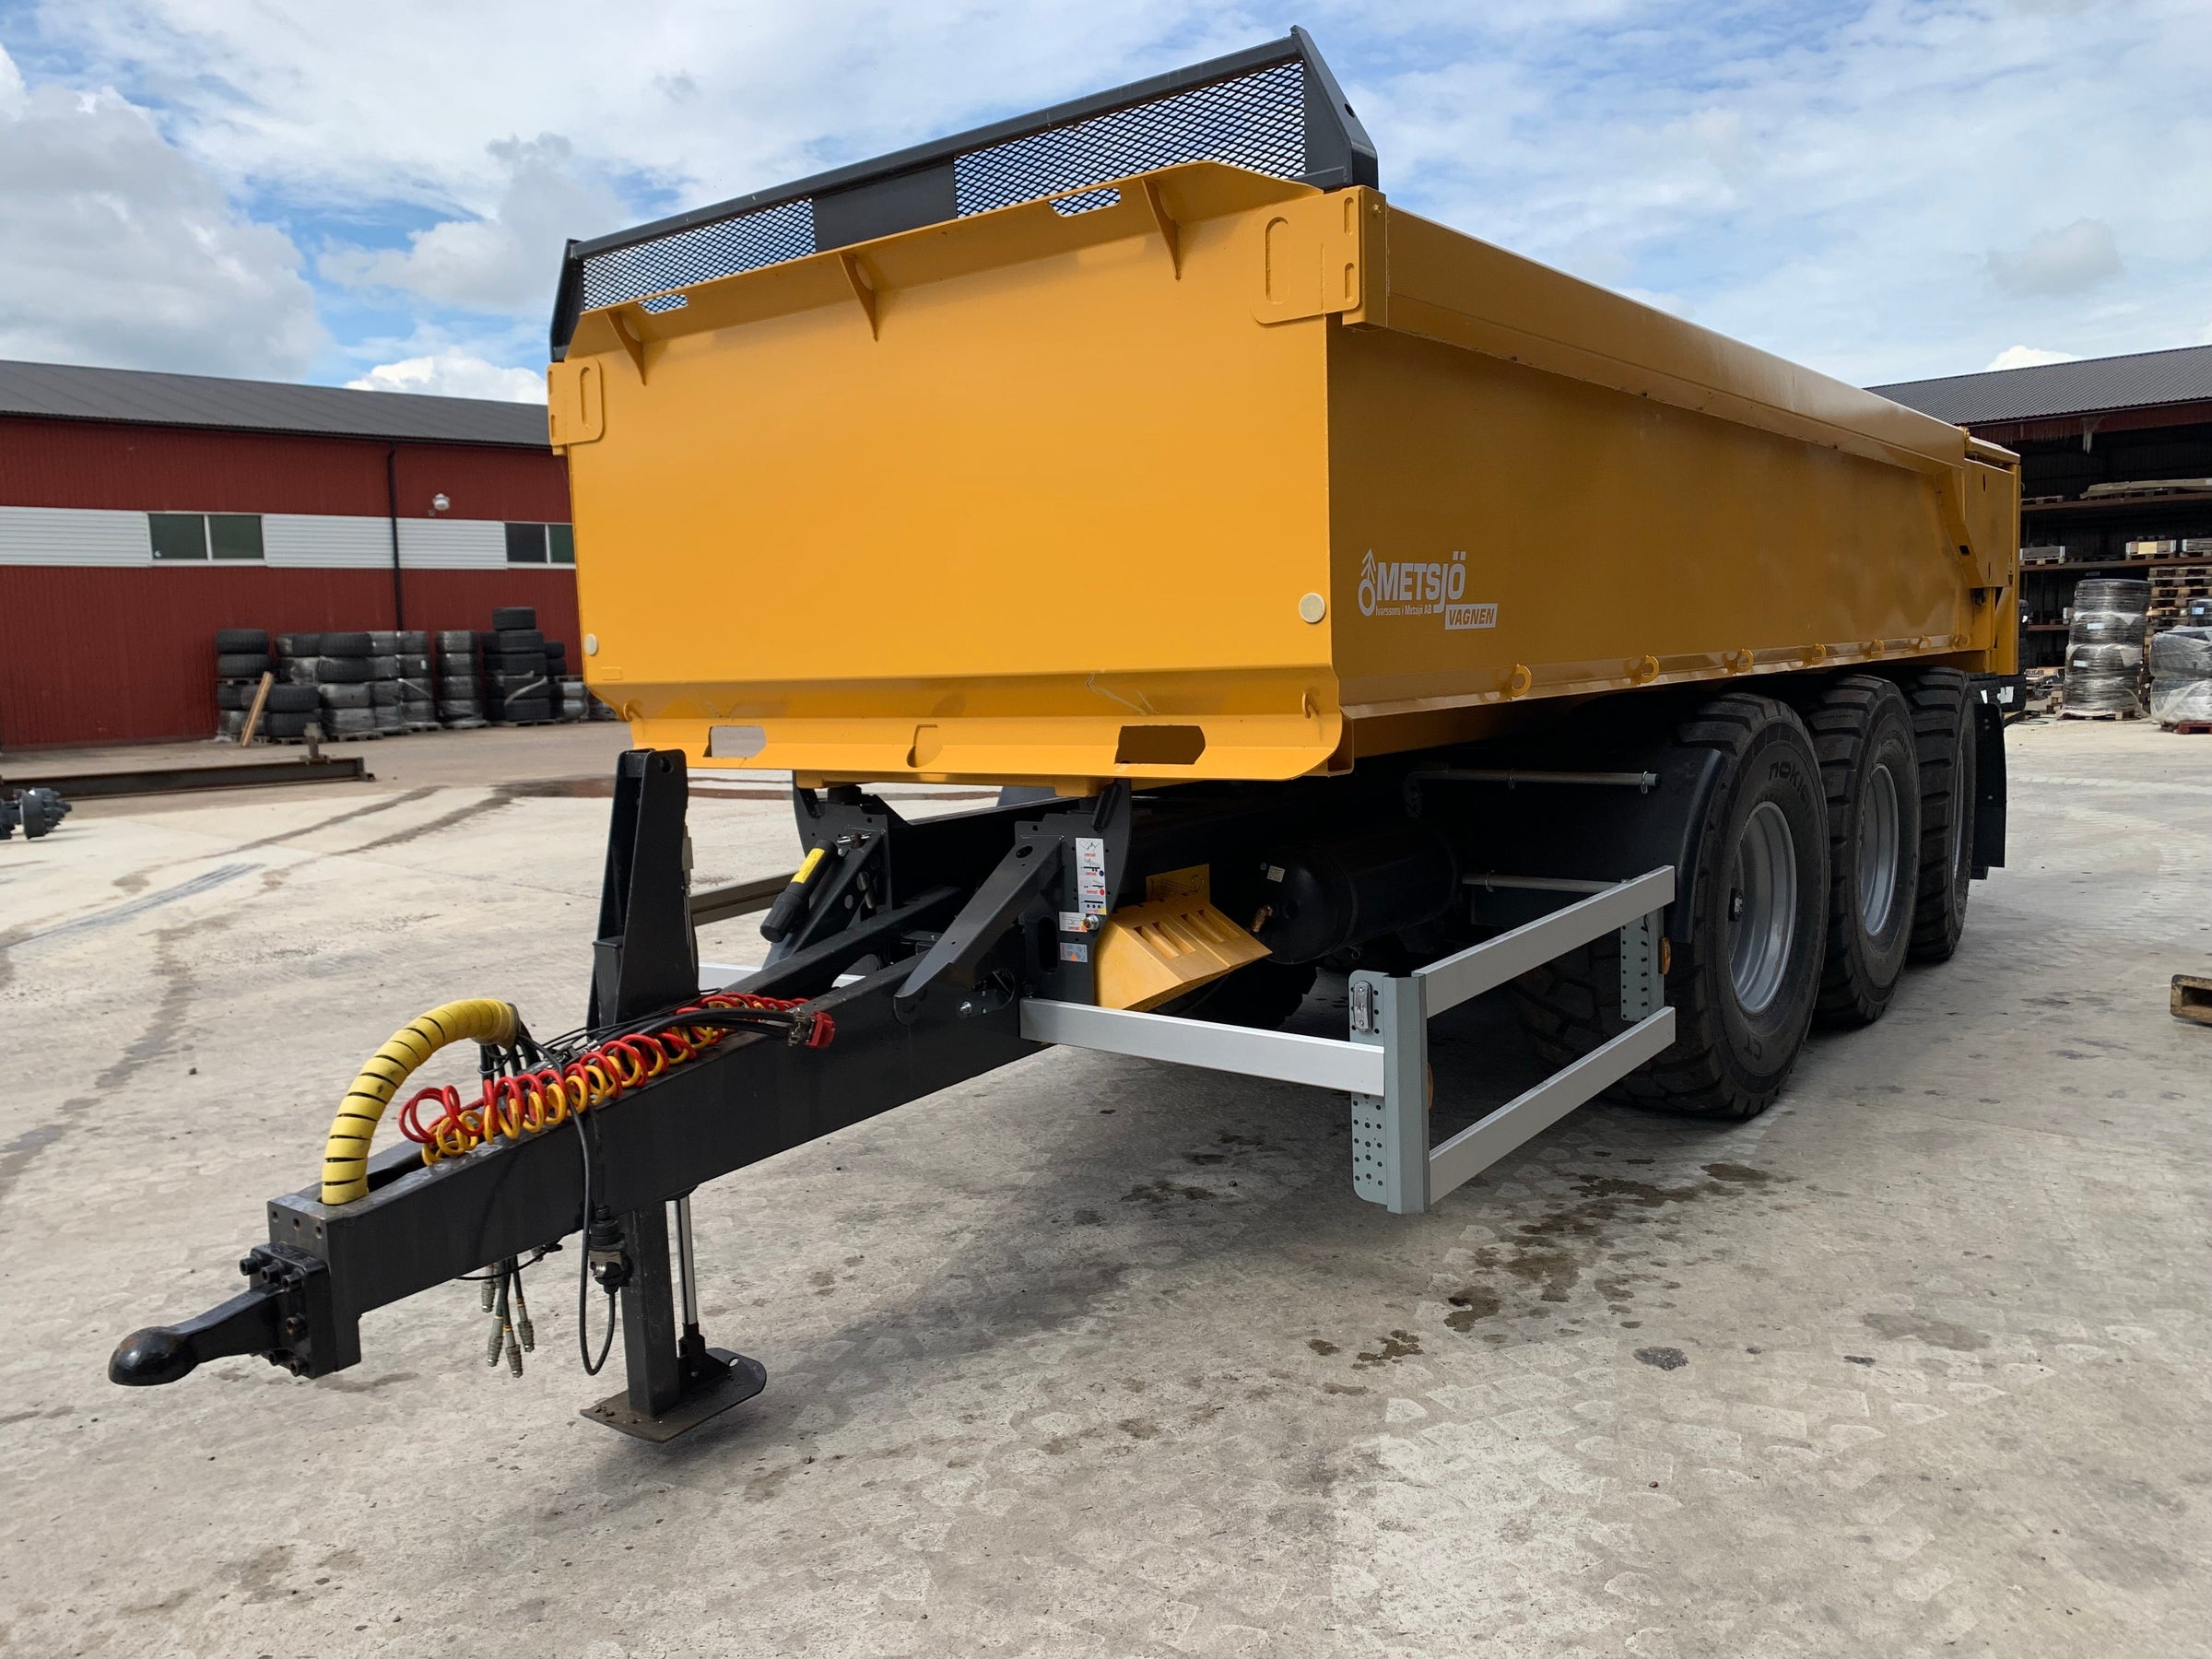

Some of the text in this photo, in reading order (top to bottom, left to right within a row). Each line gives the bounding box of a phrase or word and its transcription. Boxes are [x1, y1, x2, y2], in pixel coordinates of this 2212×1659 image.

[1376, 551, 1466, 614] METSJÖ
[1405, 605, 1423, 616] Metsjö
[1424, 605, 1432, 614] AB
[1449, 608, 1495, 626] VAGNEN
